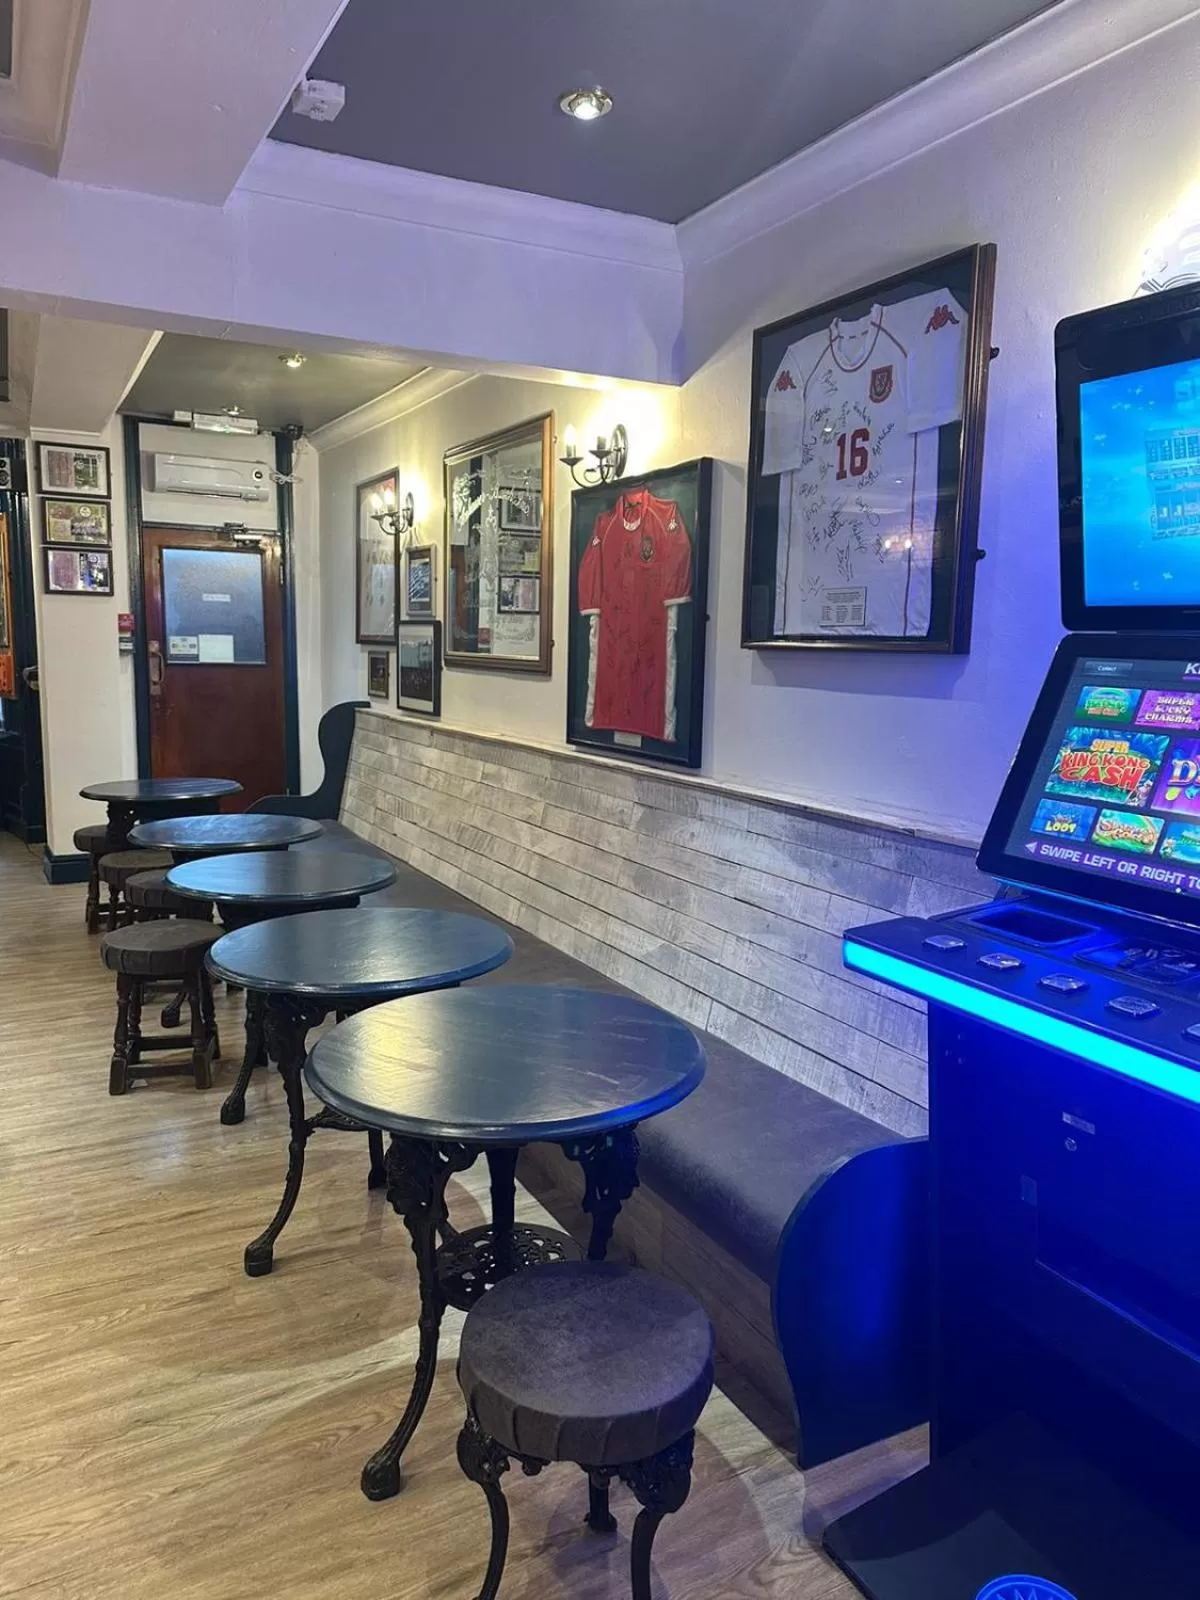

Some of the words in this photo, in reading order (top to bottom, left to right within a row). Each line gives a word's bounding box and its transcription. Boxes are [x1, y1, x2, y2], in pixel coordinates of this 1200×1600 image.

[836, 428, 870, 480] 16
[1184, 662, 1200, 674] K
[1154, 704, 1191, 714] LUCKY
[1091, 739, 1129, 753] SUPER
[1060, 751, 1100, 771] KING
[1101, 752, 1151, 770] KONG
[1059, 766, 1146, 792] CASH
[1040, 844, 1080, 862] SWIPE
[1083, 853, 1116, 870] LEFT
[1117, 861, 1138, 875] OR
[1140, 865, 1185, 886] RIGHT
